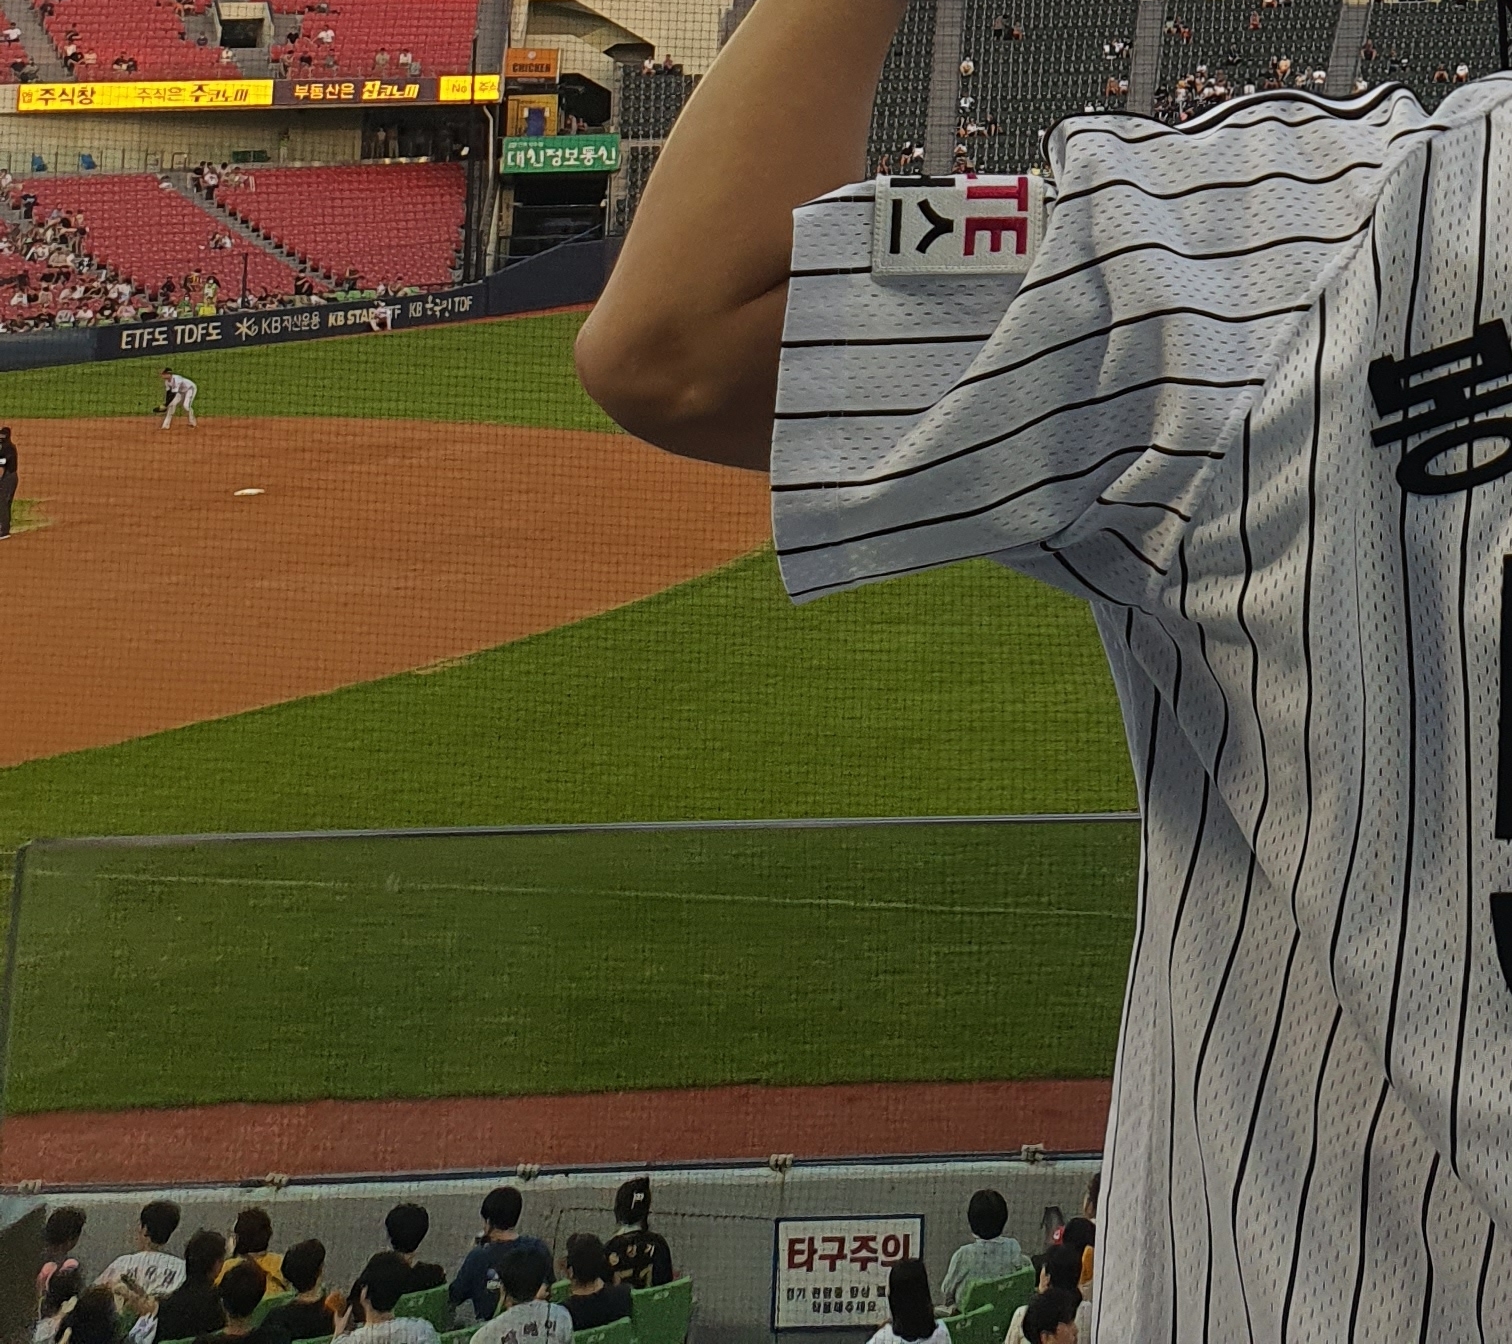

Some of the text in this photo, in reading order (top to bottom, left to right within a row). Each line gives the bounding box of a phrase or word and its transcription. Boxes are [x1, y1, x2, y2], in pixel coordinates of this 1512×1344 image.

[512, 62, 551, 73] CHICKEN
[38, 86, 95, 106] 주식창
[134, 84, 249, 103] 주식은 주코노미
[294, 80, 420, 100] 부동산은 집코노미
[507, 146, 616, 168] 대신정보통신
[409, 301, 423, 318] KB
[454, 296, 473, 312] TDF
[328, 311, 345, 327] KB
[121, 321, 222, 349] ETF도 TDF도
[788, 1234, 911, 1272] 타구주의
